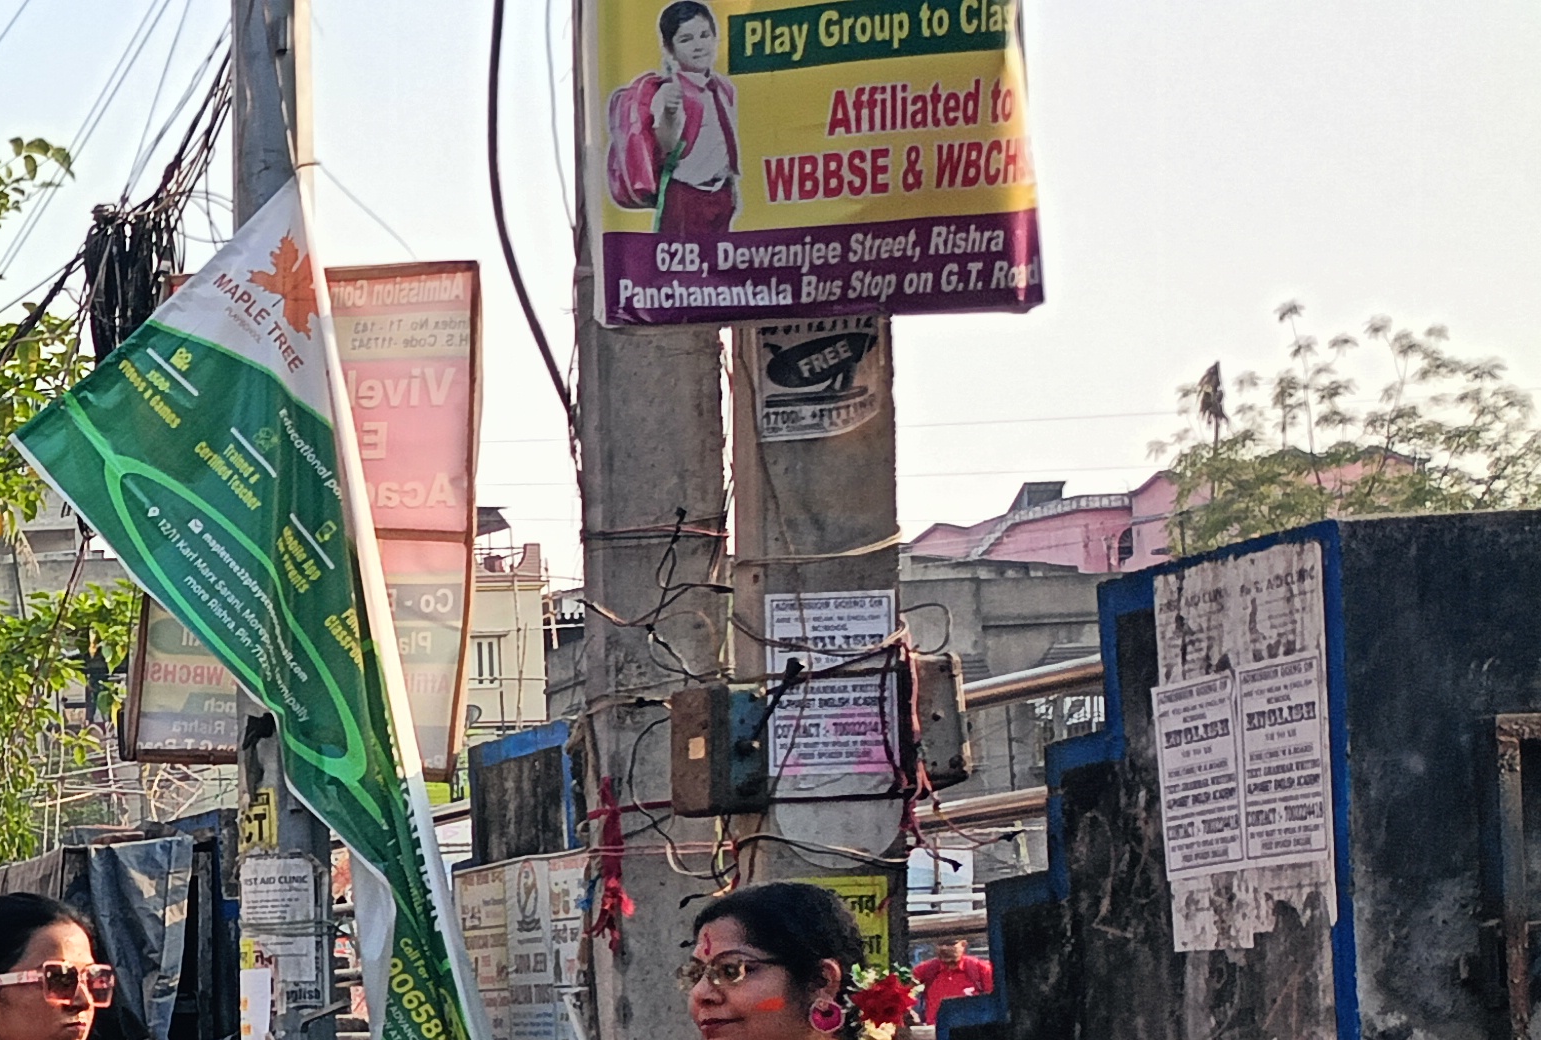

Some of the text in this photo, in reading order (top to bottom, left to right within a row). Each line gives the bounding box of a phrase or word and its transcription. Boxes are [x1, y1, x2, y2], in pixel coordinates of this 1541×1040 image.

[744, 19, 808, 60] Play
[818, 8, 910, 49] Group
[919, 3, 950, 37] to
[827, 78, 1013, 136] Affiliated to
[764, 147, 890, 203] WBBSE
[901, 145, 923, 192] &
[656, 225, 1005, 276] 62B, Dewanjee Street, Rishra
[618, 279, 793, 310] Panchanantala
[801, 275, 842, 304] Bus
[849, 268, 896, 302] Stop
[904, 269, 932, 294] on
[940, 262, 985, 293] G.T.
[213, 273, 304, 374] MAPLE TREE
[225, 306, 262, 344] PLAYSCHOOL
[797, 338, 854, 378] FREE
[150, 396, 180, 428] Games
[224, 444, 254, 477] Trained
[280, 409, 332, 478] Educational
[195, 442, 261, 509] Certified Teacher
[159, 519, 179, 541] 12/11
[177, 540, 197, 560] Karl
[195, 559, 216, 582] Marx
[303, 560, 320, 579] App
[185, 576, 209, 600] more
[1246, 700, 1316, 732] ENGLISH
[278, 874, 309, 886] CLINIC
[399, 937, 424, 960] Call
